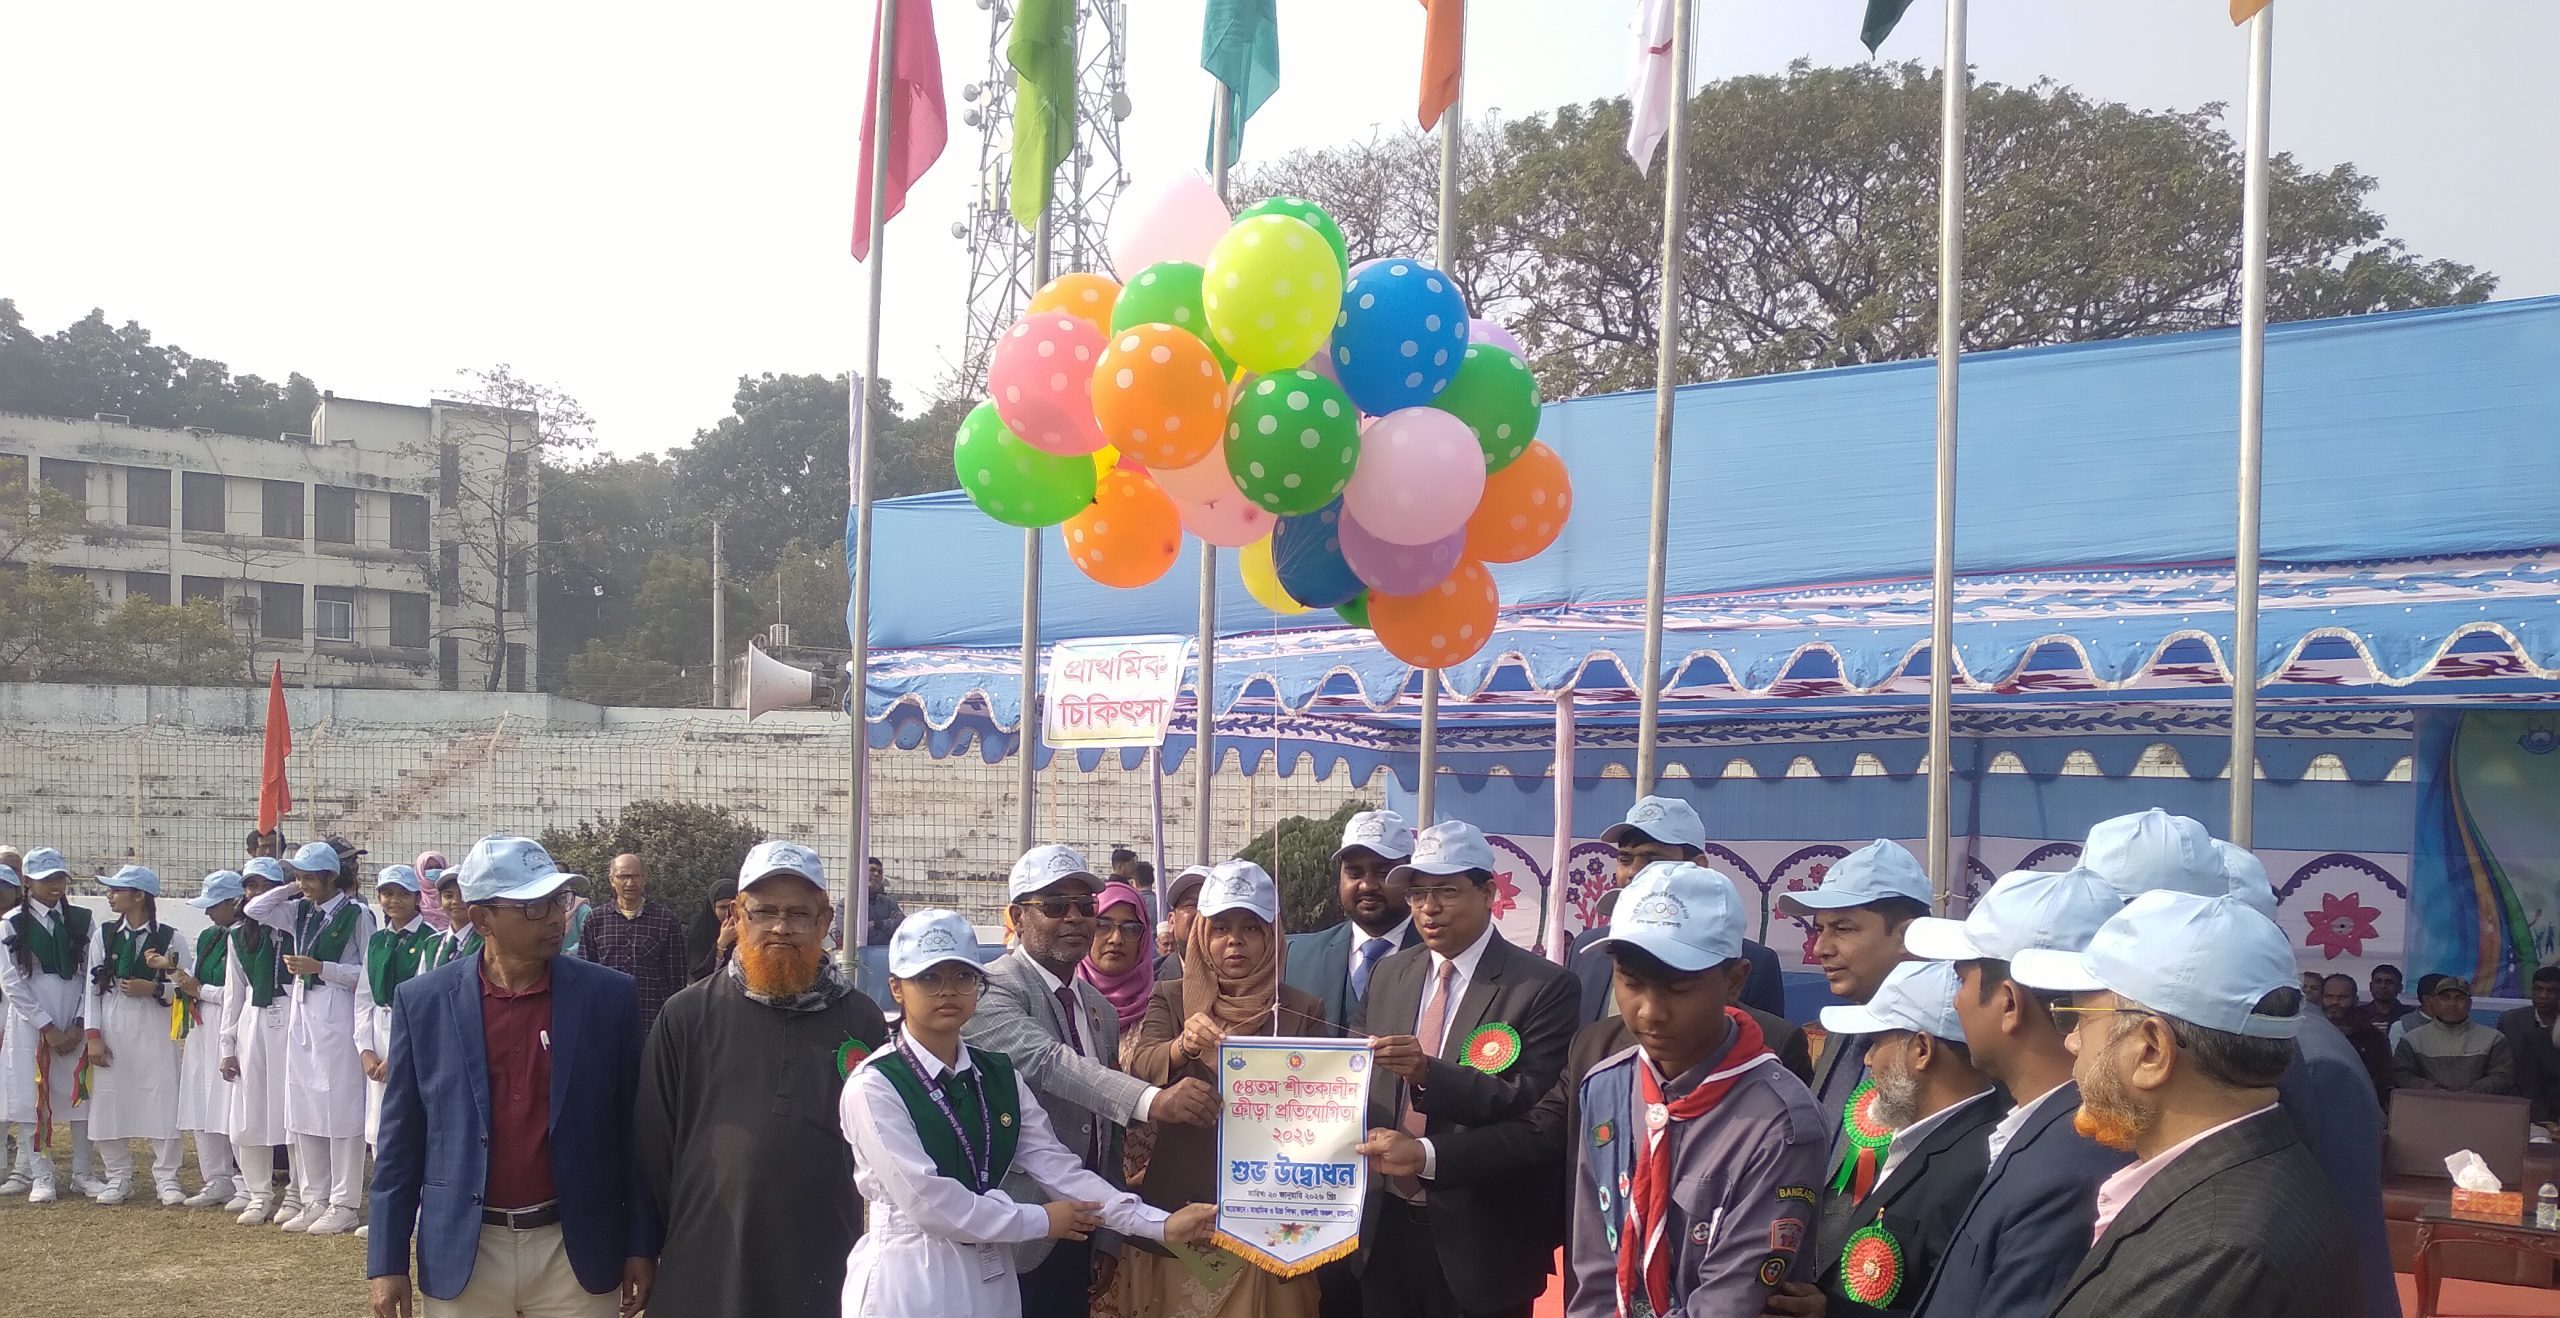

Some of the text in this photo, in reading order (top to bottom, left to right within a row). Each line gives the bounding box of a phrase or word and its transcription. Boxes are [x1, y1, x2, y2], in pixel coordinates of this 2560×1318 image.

[1064, 650, 1168, 682] প্রাথমিক
[1058, 693, 1168, 728] চিকিৎসা
[1232, 1075, 1360, 1098] ৫৪তম শীতকালীন
[1230, 1097, 1358, 1122] ক্রীড়া প্রতিযোগিতা
[1272, 1127, 1316, 1146] ২০২৬
[1231, 1152, 1357, 1188] শুভ উদ্বোধন
[1267, 1191, 1277, 1199] ২০
